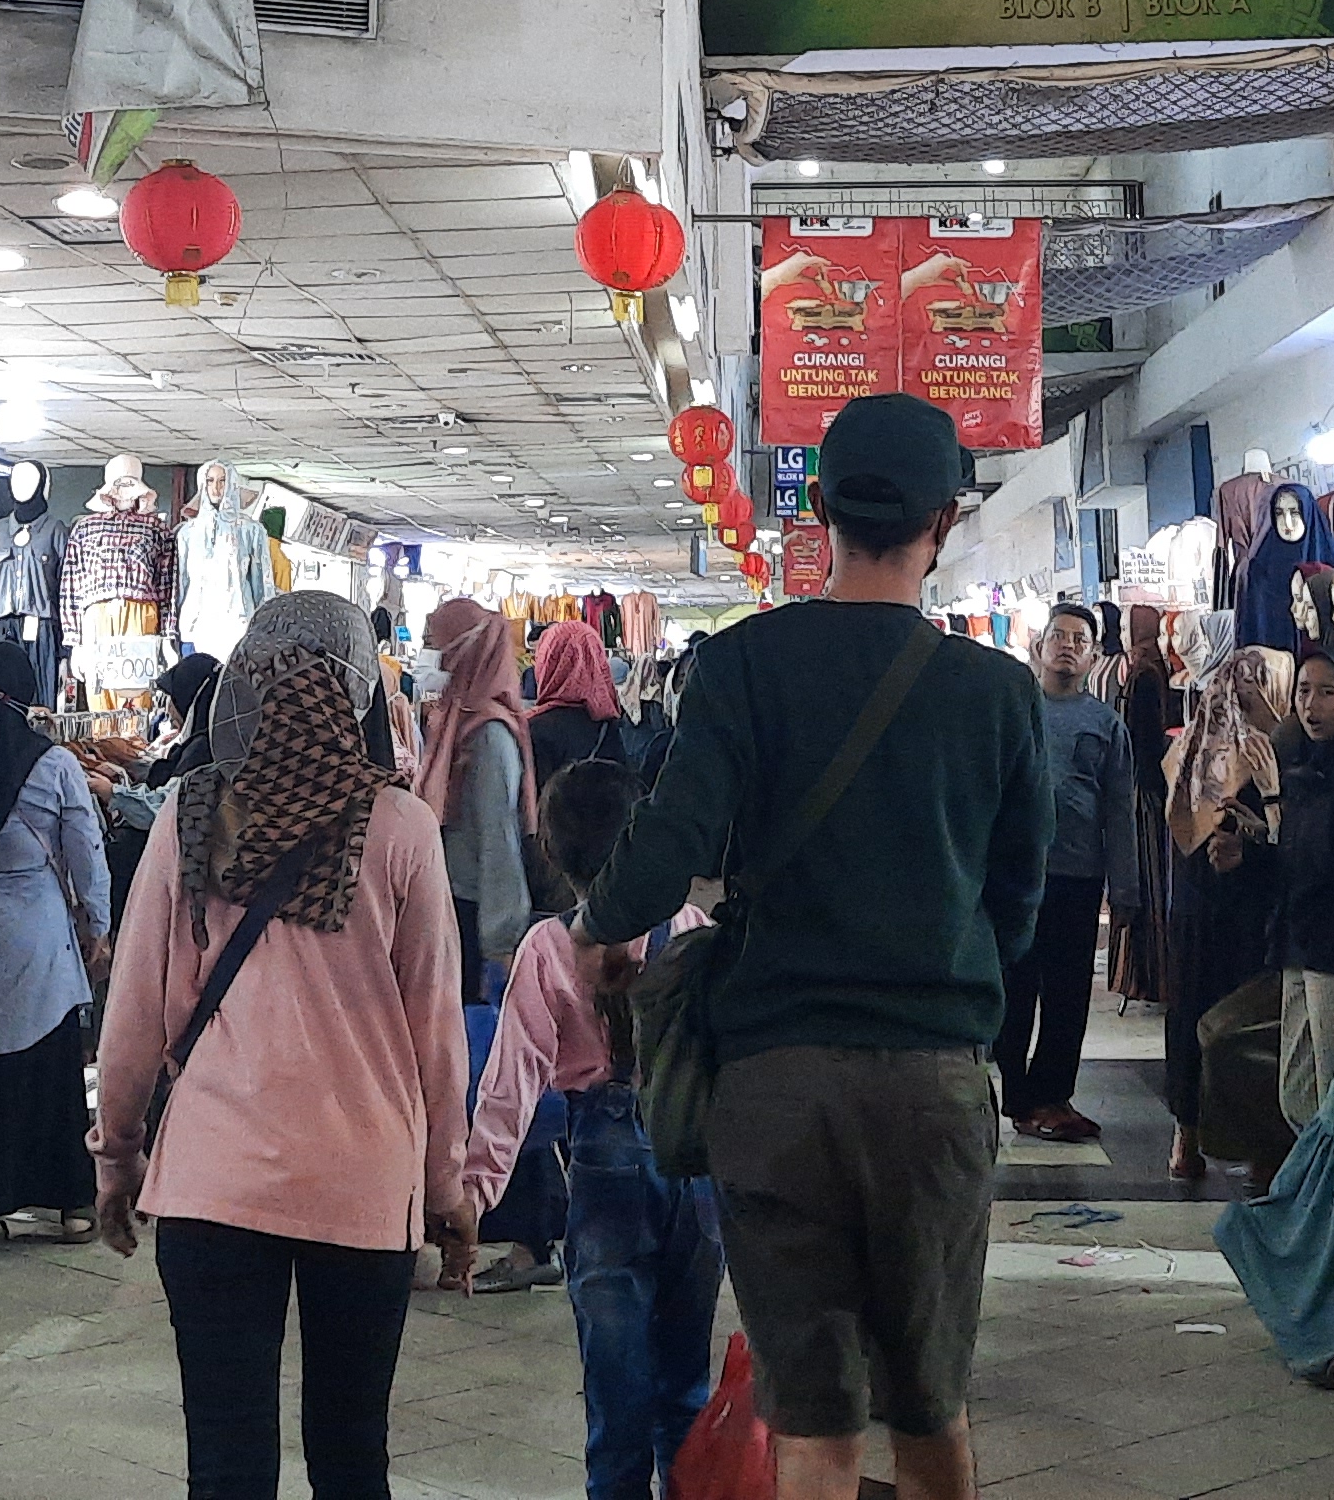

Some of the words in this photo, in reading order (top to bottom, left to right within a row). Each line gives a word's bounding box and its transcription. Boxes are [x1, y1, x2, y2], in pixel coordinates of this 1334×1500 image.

[780, 369, 845, 382] UNTUNG
[849, 369, 878, 382] TAK
[920, 370, 986, 383] UNTUNG
[990, 371, 1020, 384] TAK
[777, 448, 804, 469] LG
[776, 489, 797, 507] LG
